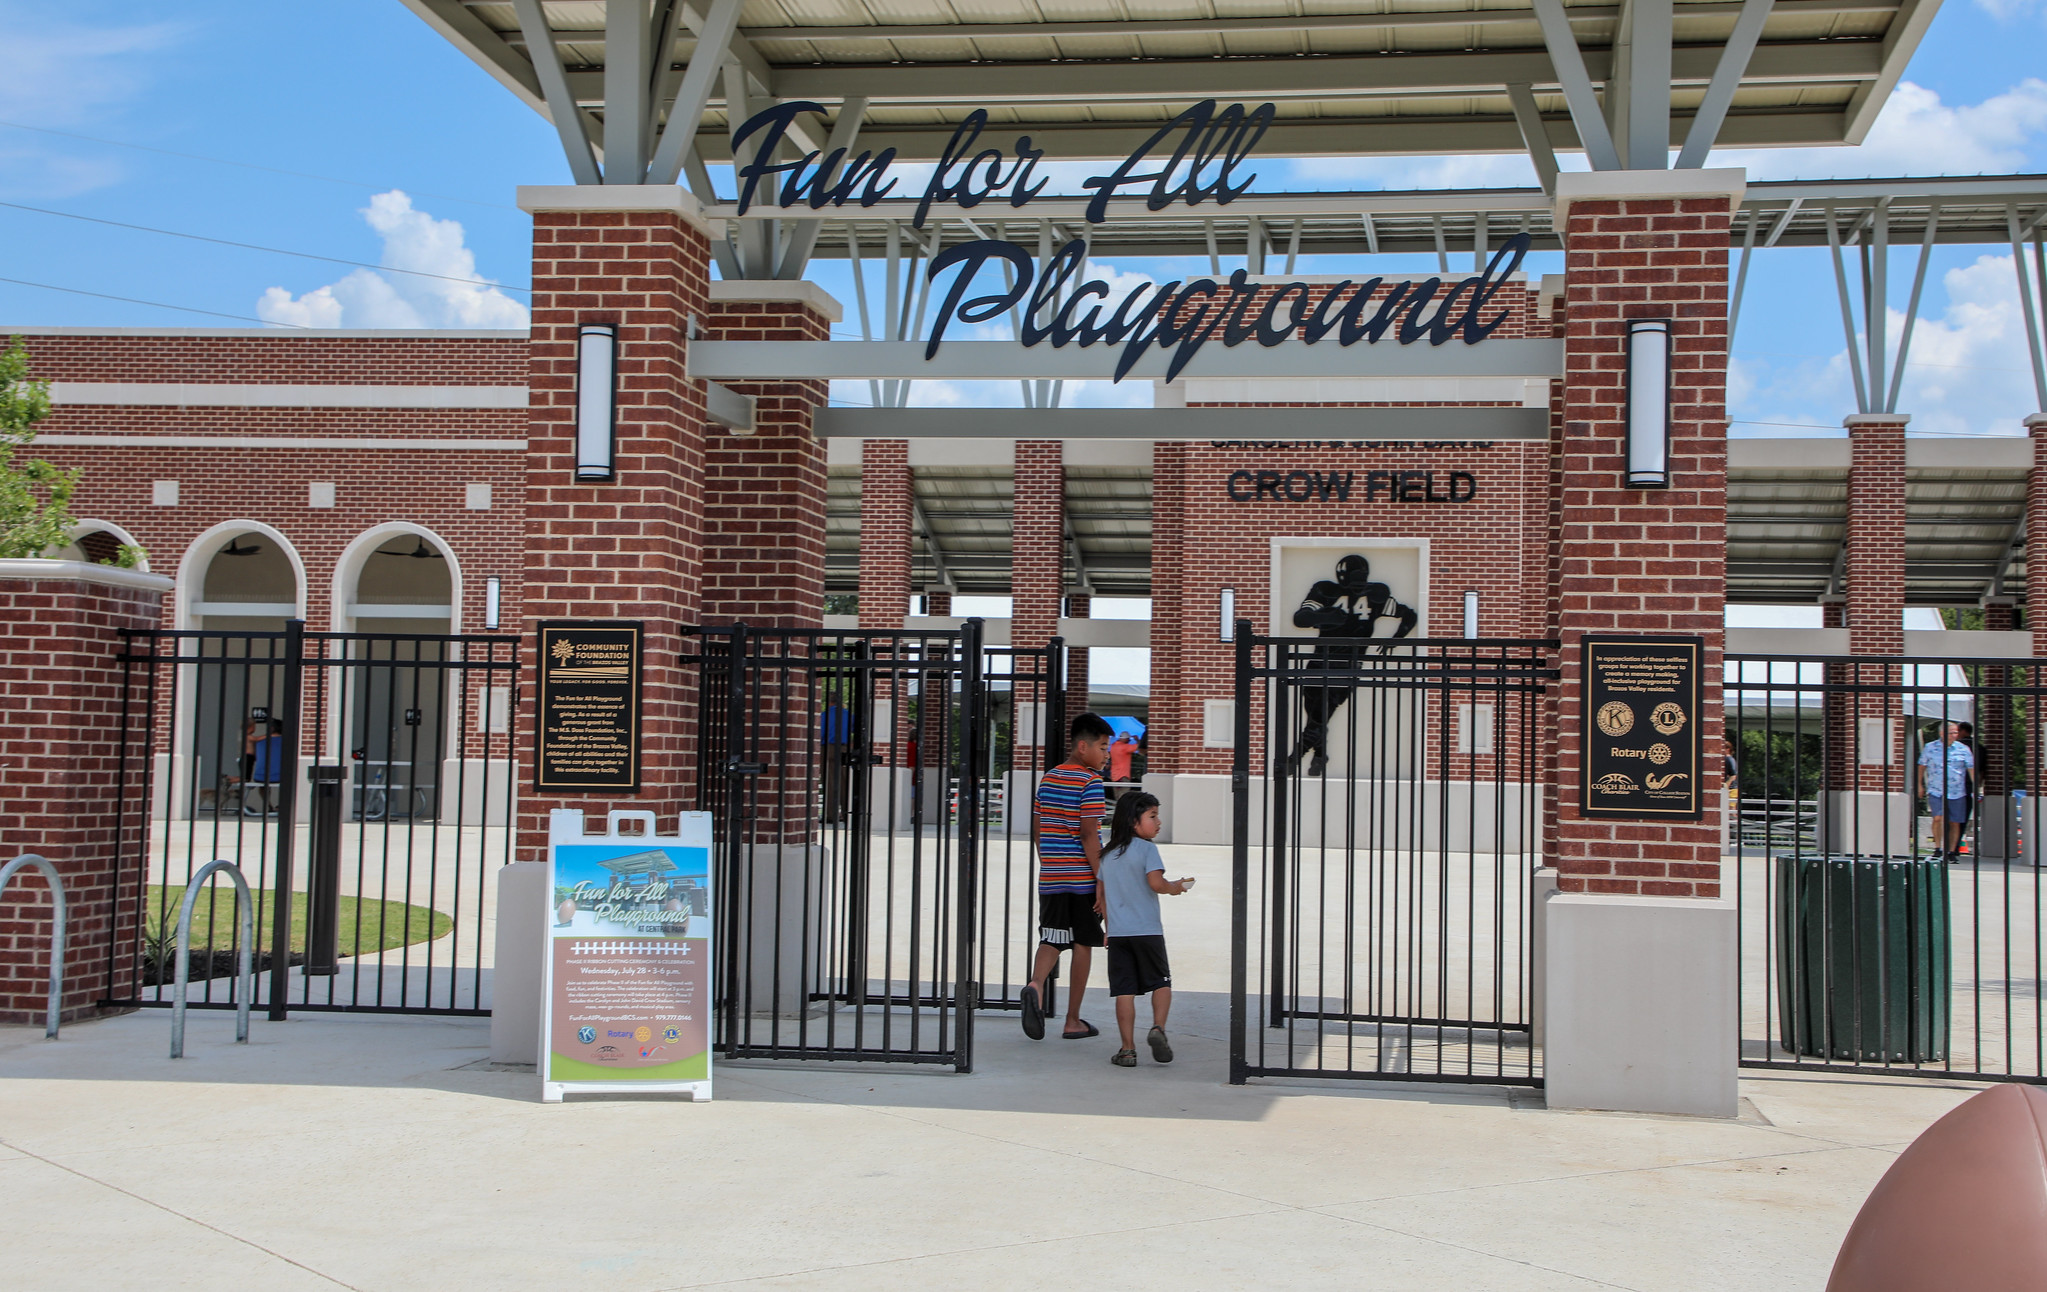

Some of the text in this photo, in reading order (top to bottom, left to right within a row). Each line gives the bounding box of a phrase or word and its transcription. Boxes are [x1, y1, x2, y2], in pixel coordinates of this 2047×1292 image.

[731, 98, 1276, 228] Fun for All
[925, 232, 1532, 384] Playground
[1227, 470, 1477, 503] CROW FIELD
[1331, 595, 1372, 620] 44
[1663, 712, 1674, 724] L
[1611, 747, 1647, 759] Rotary
[573, 880, 669, 903] Fun for All
[594, 903, 691, 927] Playground
[621, 967, 635, 976] July
[582, 1028, 593, 1041] K
[607, 1030, 634, 1039] Rotary
